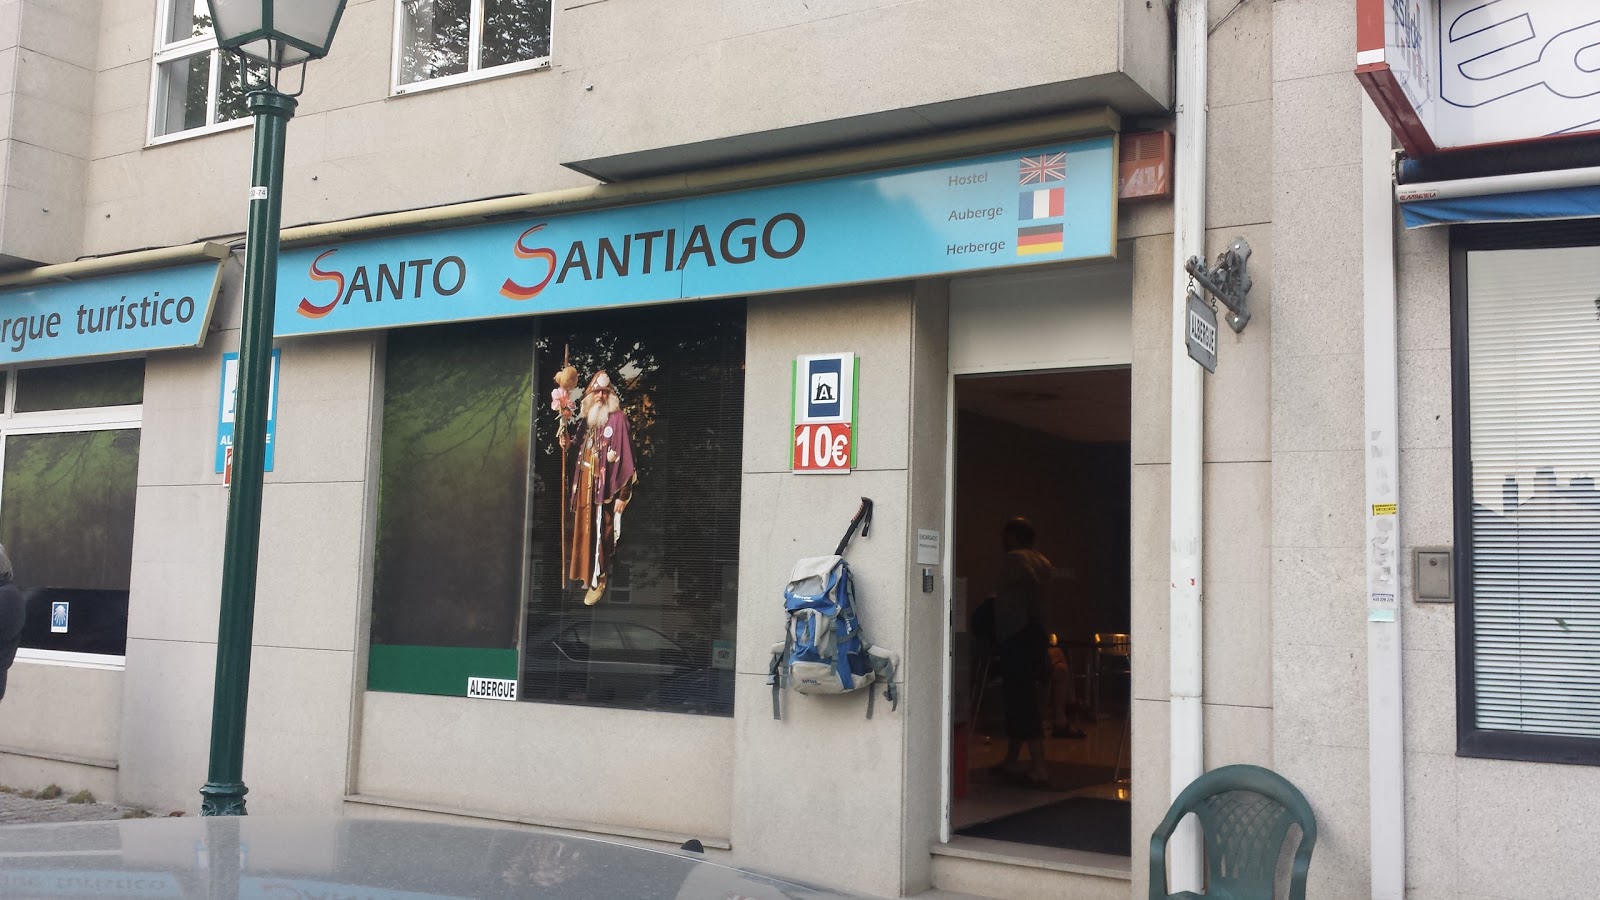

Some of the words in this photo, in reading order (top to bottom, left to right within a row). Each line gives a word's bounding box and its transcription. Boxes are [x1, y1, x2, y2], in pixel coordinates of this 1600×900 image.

[948, 171, 989, 187] Hostel
[947, 207, 1004, 222] Auberge
[946, 241, 1006, 256] Herberge
[295, 249, 467, 320] SANTO
[499, 212, 806, 300] SANTIAGO
[0, 311, 62, 353] rgue
[76, 291, 195, 335] turístico
[1191, 313, 1215, 352] ALBERGUE
[796, 425, 849, 467] 10€
[469, 679, 516, 699] ALBERGUE
